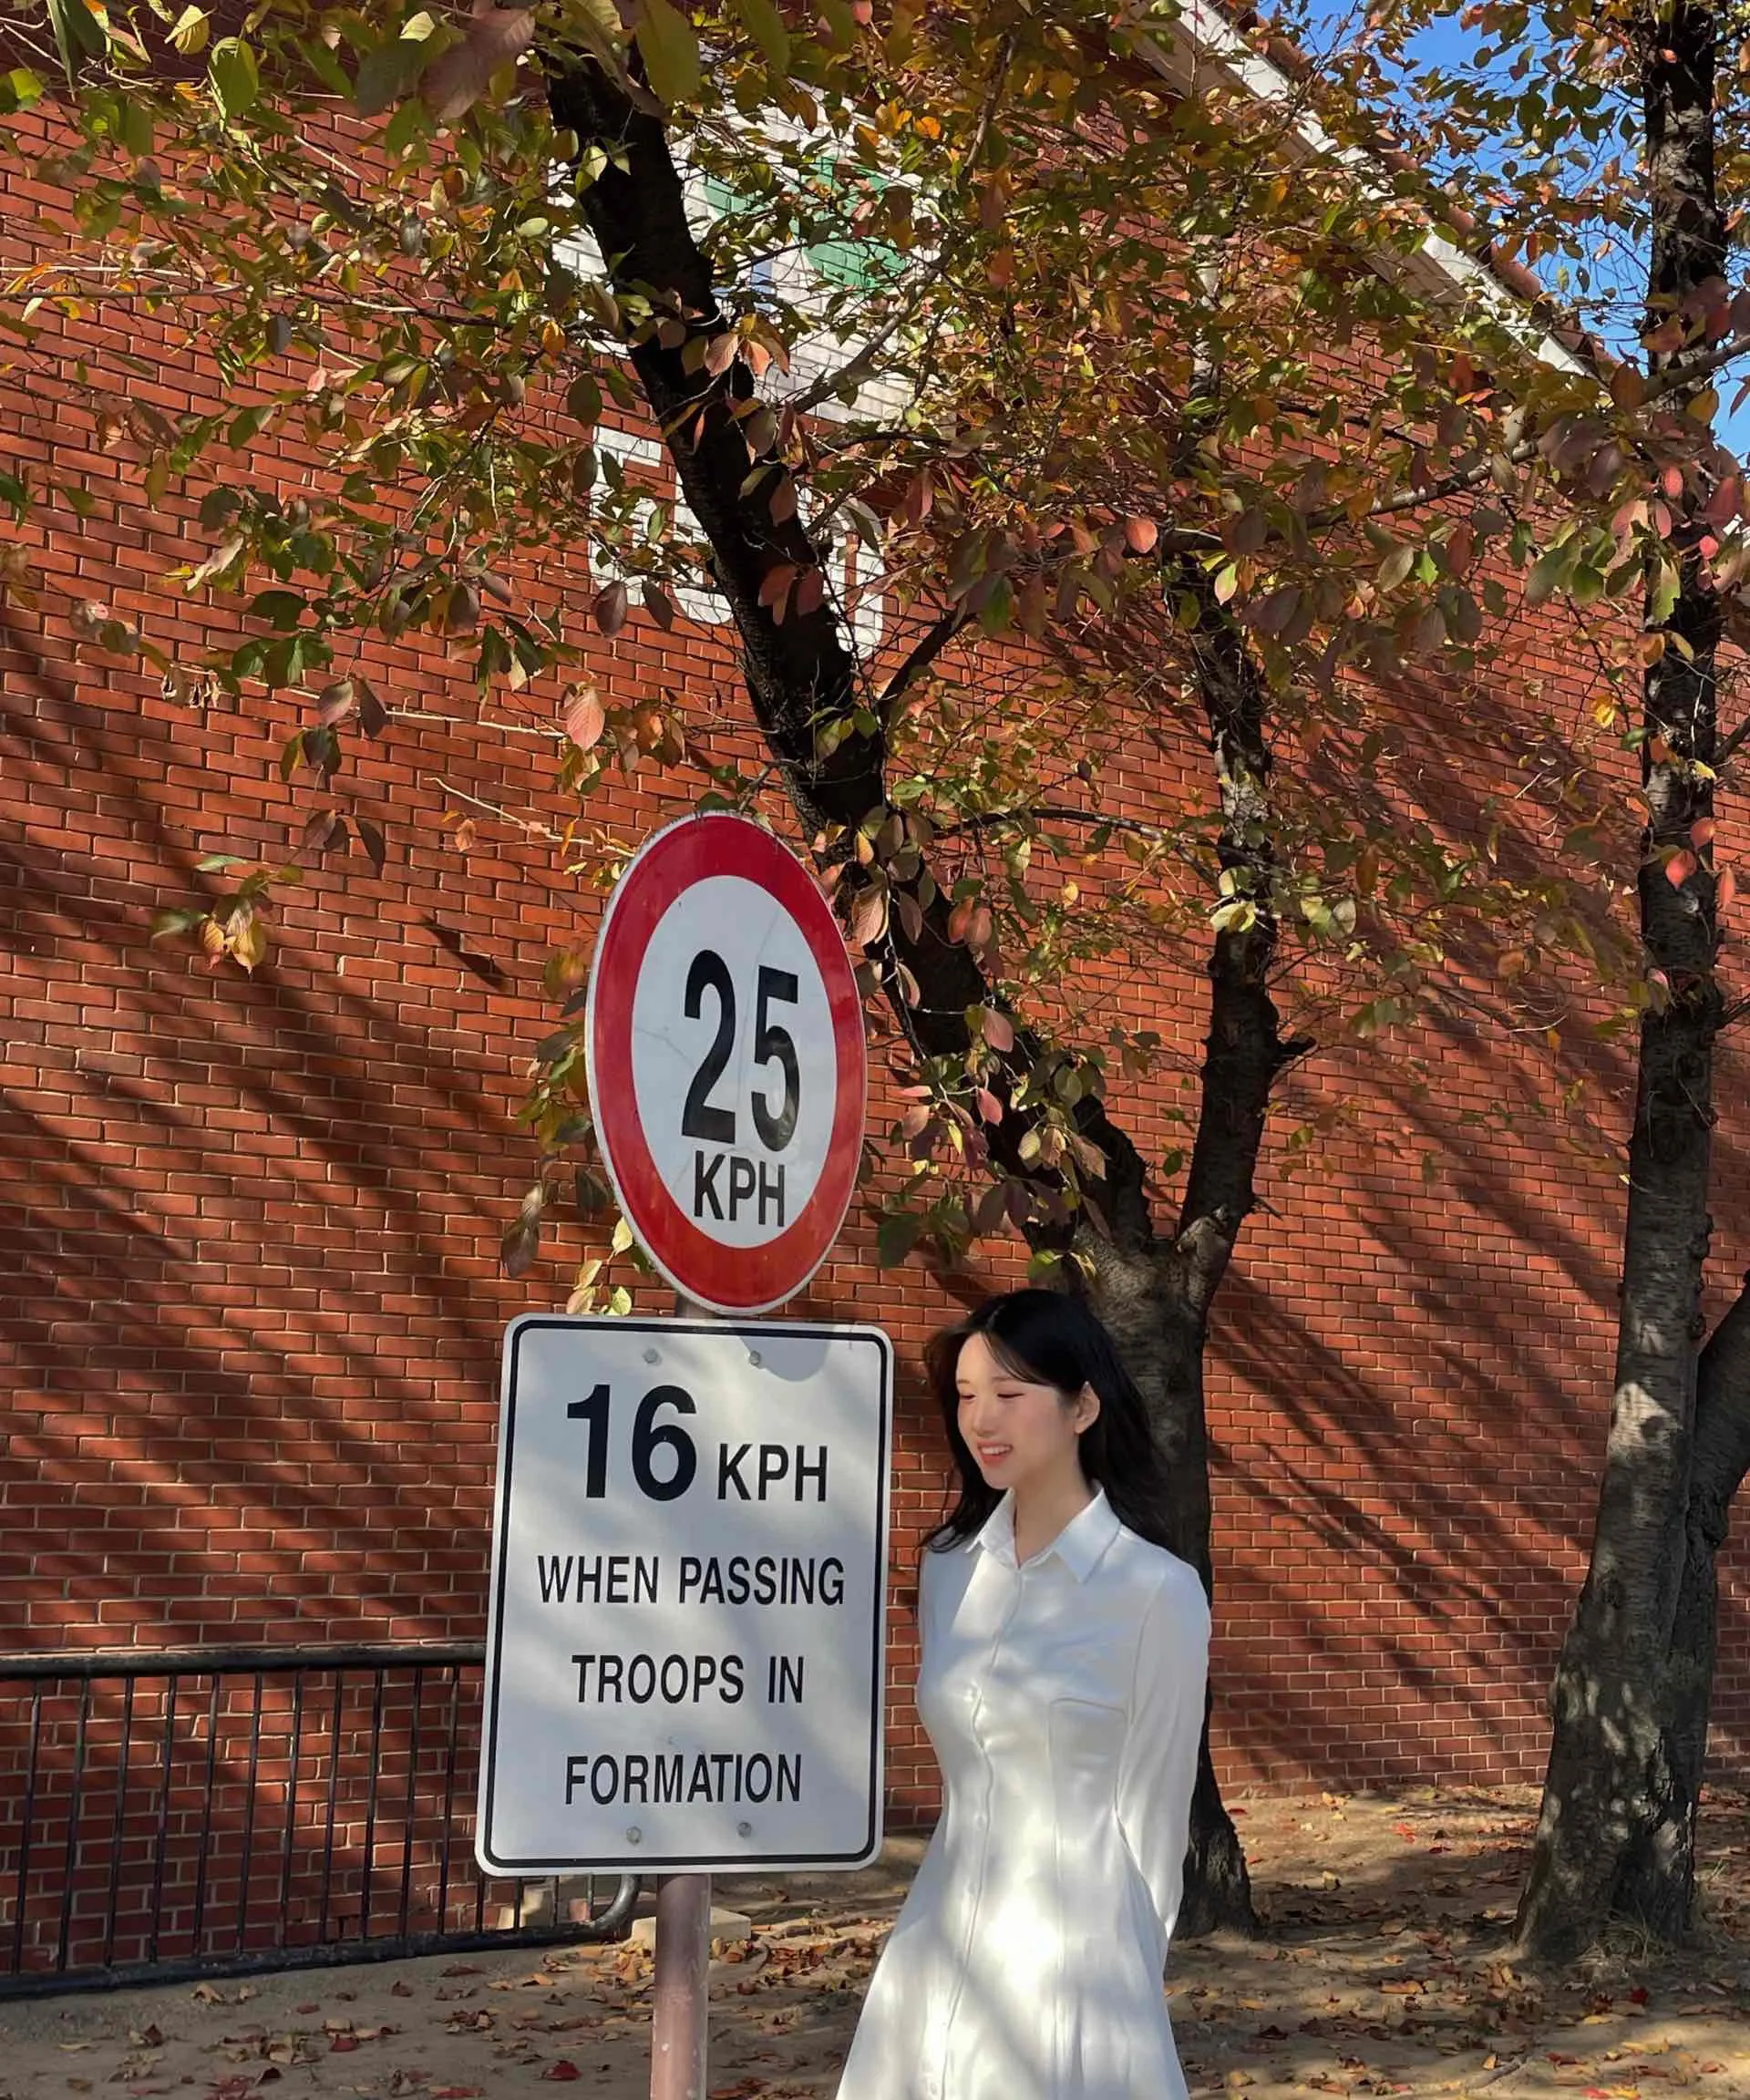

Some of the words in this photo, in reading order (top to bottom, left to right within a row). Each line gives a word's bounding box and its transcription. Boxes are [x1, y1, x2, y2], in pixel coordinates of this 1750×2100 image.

[681, 949, 800, 1152] 25
[693, 1149, 786, 1228] KPH
[566, 1384, 697, 1502] 16
[716, 1443, 829, 1502] KPH
[537, 1554, 659, 1604] WHEN
[678, 1556, 845, 1606] PASSING
[571, 1653, 745, 1704] TROOPS
[767, 1655, 805, 1704] IN
[564, 1753, 803, 1806] FORMATION
